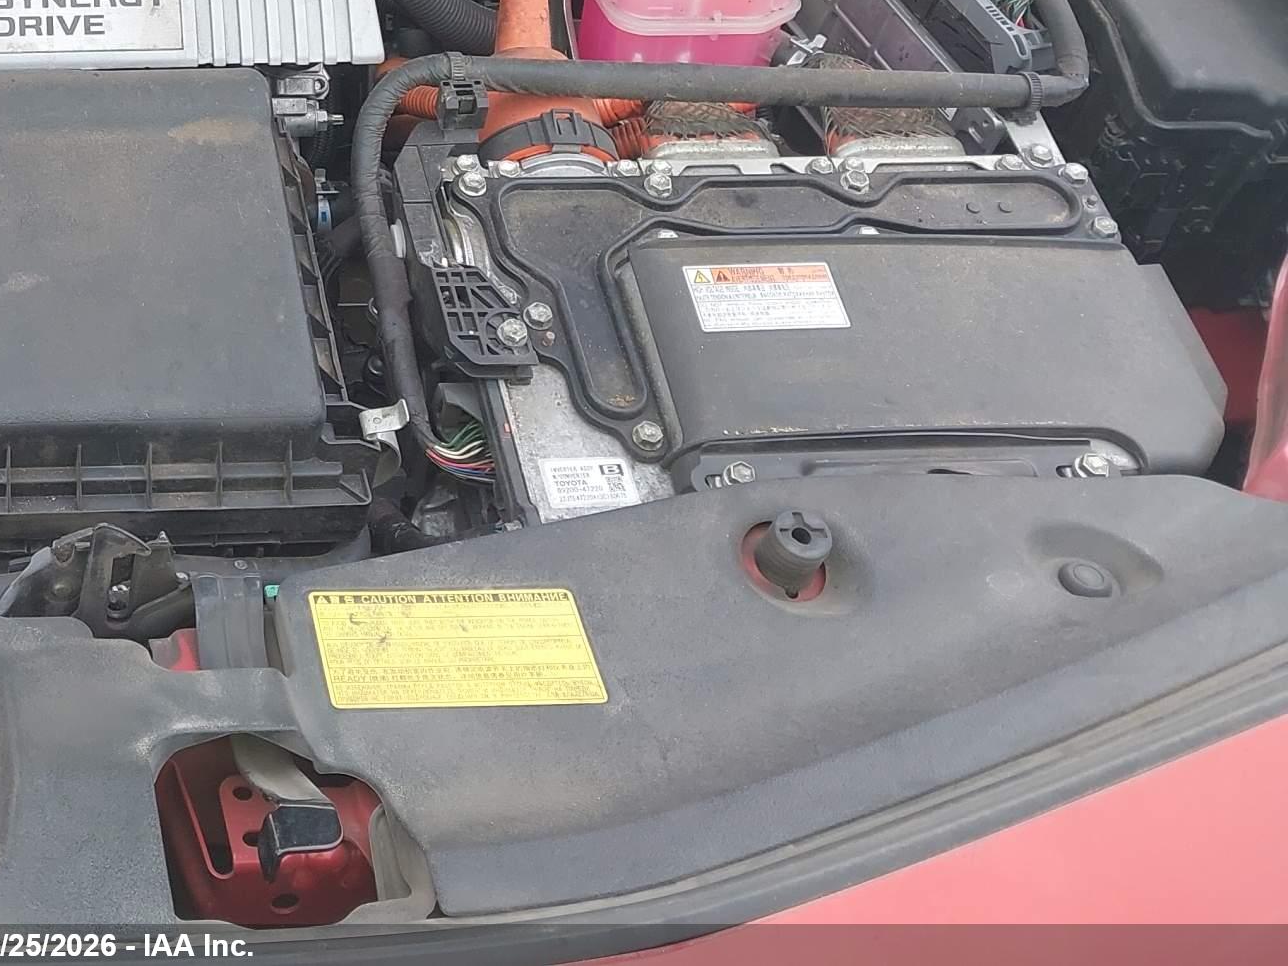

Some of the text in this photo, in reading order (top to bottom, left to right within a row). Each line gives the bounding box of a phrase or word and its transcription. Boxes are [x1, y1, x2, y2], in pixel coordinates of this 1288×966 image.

[603, 465, 620, 475] B
[361, 595, 417, 604] CAUTION
[423, 594, 494, 603] ATTENTION
[499, 592, 568, 602] ВНИМАНИЕ
